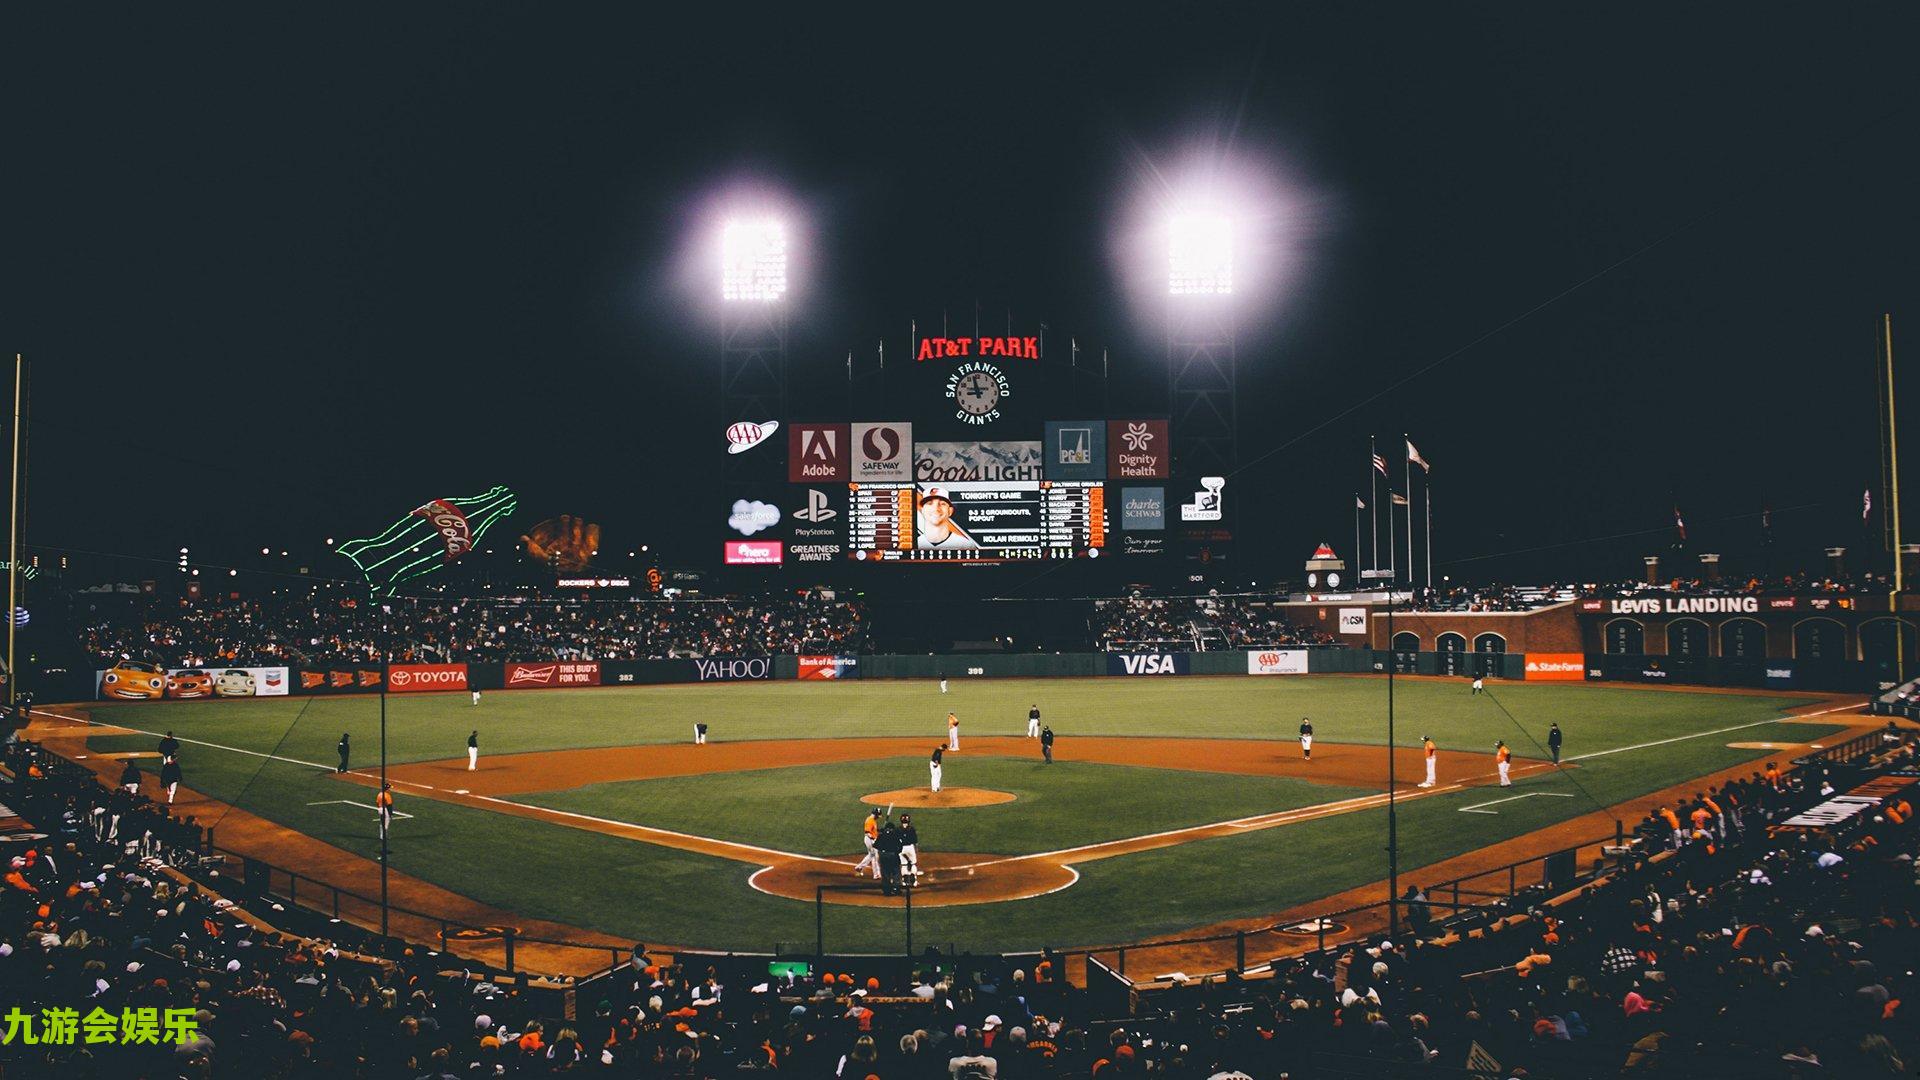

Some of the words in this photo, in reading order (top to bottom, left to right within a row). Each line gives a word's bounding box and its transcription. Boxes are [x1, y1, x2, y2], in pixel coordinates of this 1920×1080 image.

[918, 338, 972, 360] AT&T
[979, 336, 1039, 360] PARK
[946, 374, 960, 398] SAN
[958, 361, 1010, 397] FRANCISCO
[956, 409, 1000, 425] GIANTS
[729, 423, 762, 443] AAA
[1060, 450, 1090, 463] PG&E
[1119, 454, 1157, 466] Dignity
[802, 464, 836, 476] Adobe
[862, 462, 900, 470] SAFEWAY
[915, 458, 982, 481] Coors
[984, 465, 1043, 481] LIGHT
[1121, 466, 1156, 477] Health
[960, 492, 999, 500] TONIGHT'S
[1125, 499, 1161, 510] charles
[734, 511, 775, 521] salesforce
[1125, 510, 1161, 518] SCHWAB
[795, 528, 835, 537] PlayStation
[790, 544, 840, 554] GREATNESS
[798, 553, 832, 561] AWAITS
[558, 579, 595, 587] DOCKERS
[1666, 597, 1758, 613] LANDING
[1350, 616, 1364, 625] CSN
[800, 658, 818, 666] Bank
[819, 658, 827, 666] of
[826, 658, 856, 666] America
[1118, 654, 1175, 674] VISA
[1562, 662, 1584, 671] Farm
[559, 664, 574, 673] THIS
[576, 663, 598, 673] BUD'S
[696, 658, 770, 681] YAHOO!
[413, 671, 467, 683] TOYOTA
[559, 673, 574, 682] FOR
[575, 672, 590, 682] YOU.
